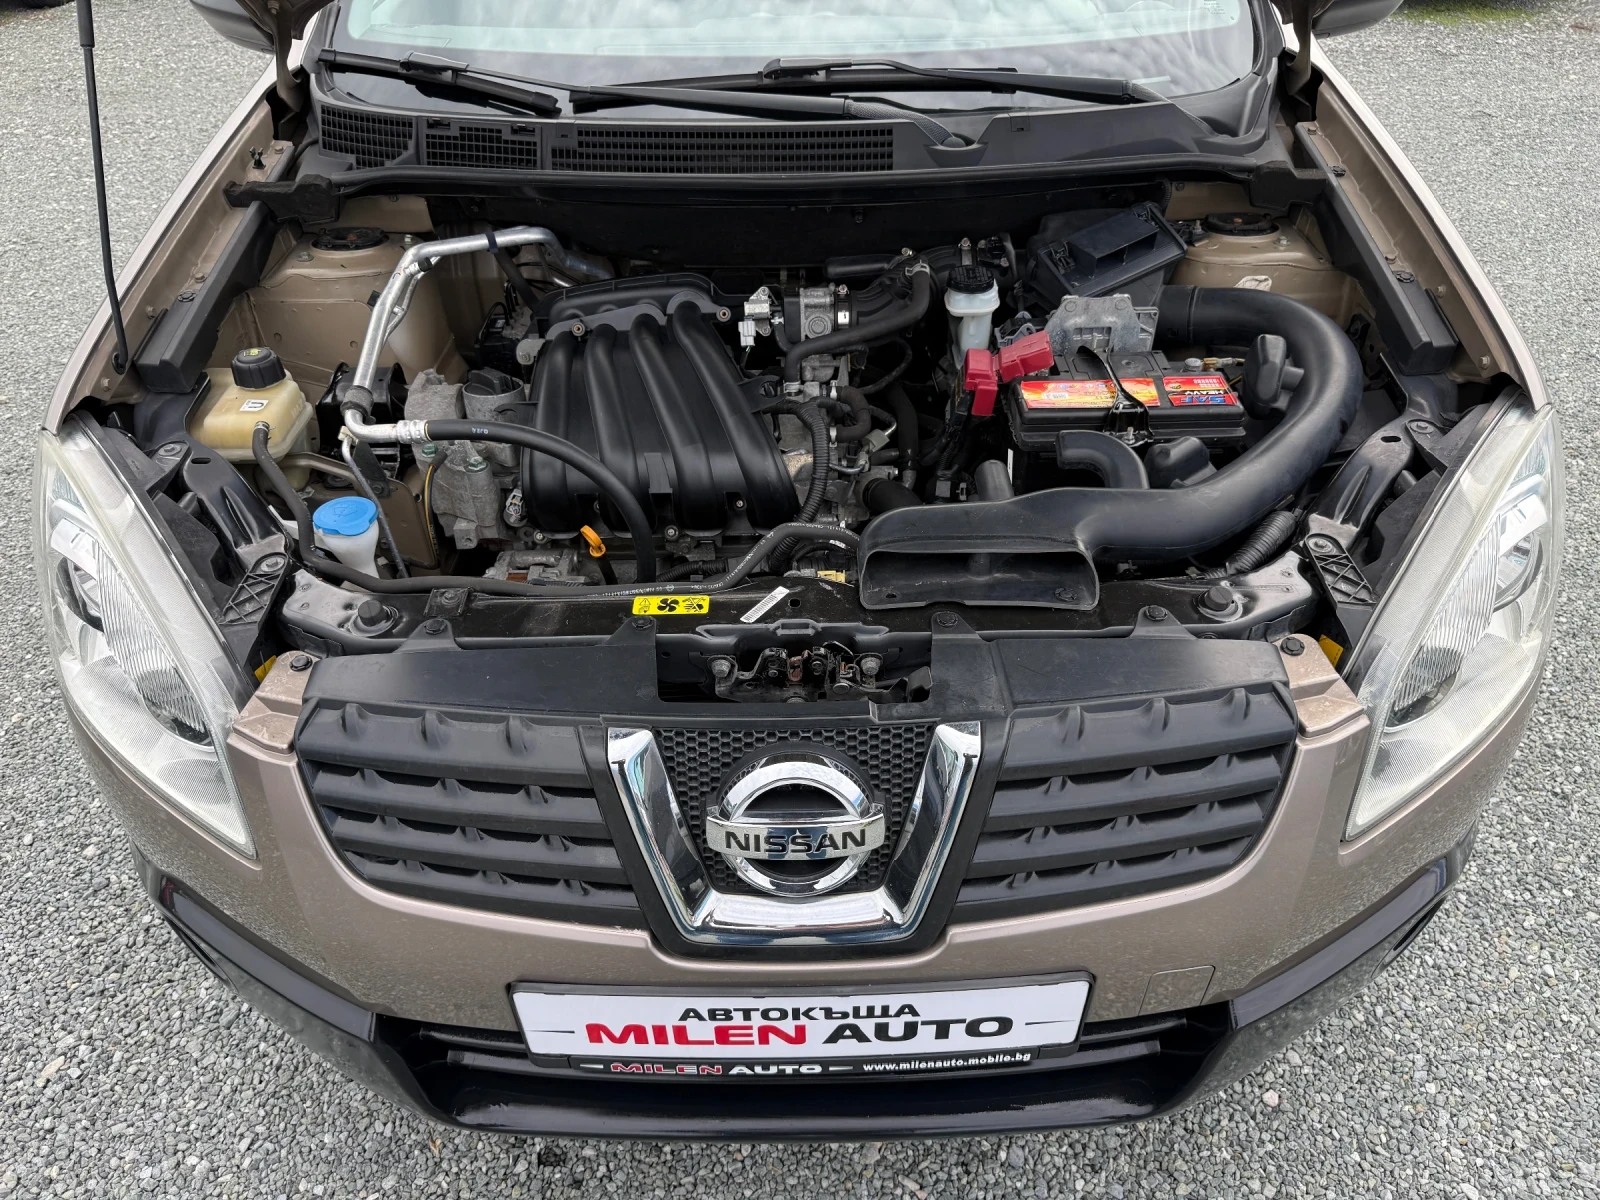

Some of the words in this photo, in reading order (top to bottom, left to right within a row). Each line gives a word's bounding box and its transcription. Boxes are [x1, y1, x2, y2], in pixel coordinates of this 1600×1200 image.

[1180, 395, 1226, 404] SAF
[725, 829, 866, 853] NISSAN
[678, 1004, 921, 1021] АВТОКЪЩА
[585, 1023, 806, 1045] MILEN
[822, 1016, 1013, 1044] AUTO
[610, 1063, 722, 1074] MILEN
[728, 1063, 822, 1075] AUTO
[863, 1052, 1031, 1072] www.milenauto.mobile.bg
